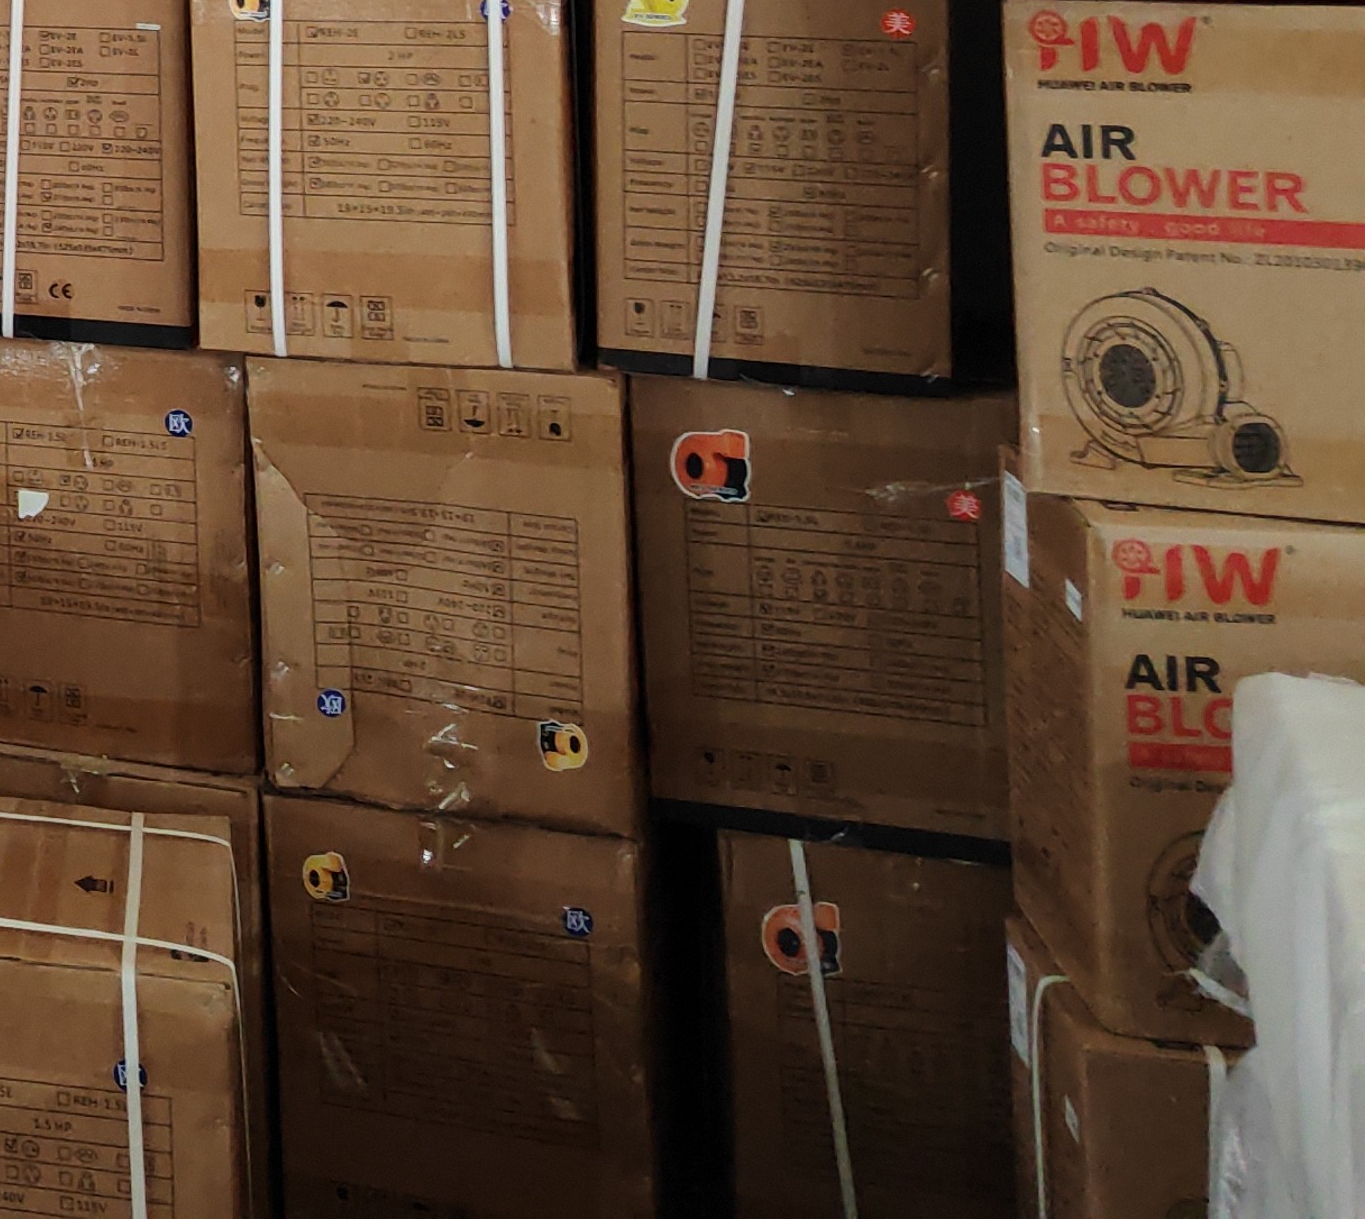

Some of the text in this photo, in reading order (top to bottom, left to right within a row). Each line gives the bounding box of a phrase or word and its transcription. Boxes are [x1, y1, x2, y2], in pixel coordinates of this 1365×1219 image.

[886, 13, 911, 35] 美
[1041, 123, 1136, 161] AIR
[1039, 162, 1309, 213] BLOWER
[169, 413, 190, 434] 欧
[954, 494, 977, 518] 美
[1124, 653, 1222, 694] AIR
[567, 911, 589, 930] 欧
